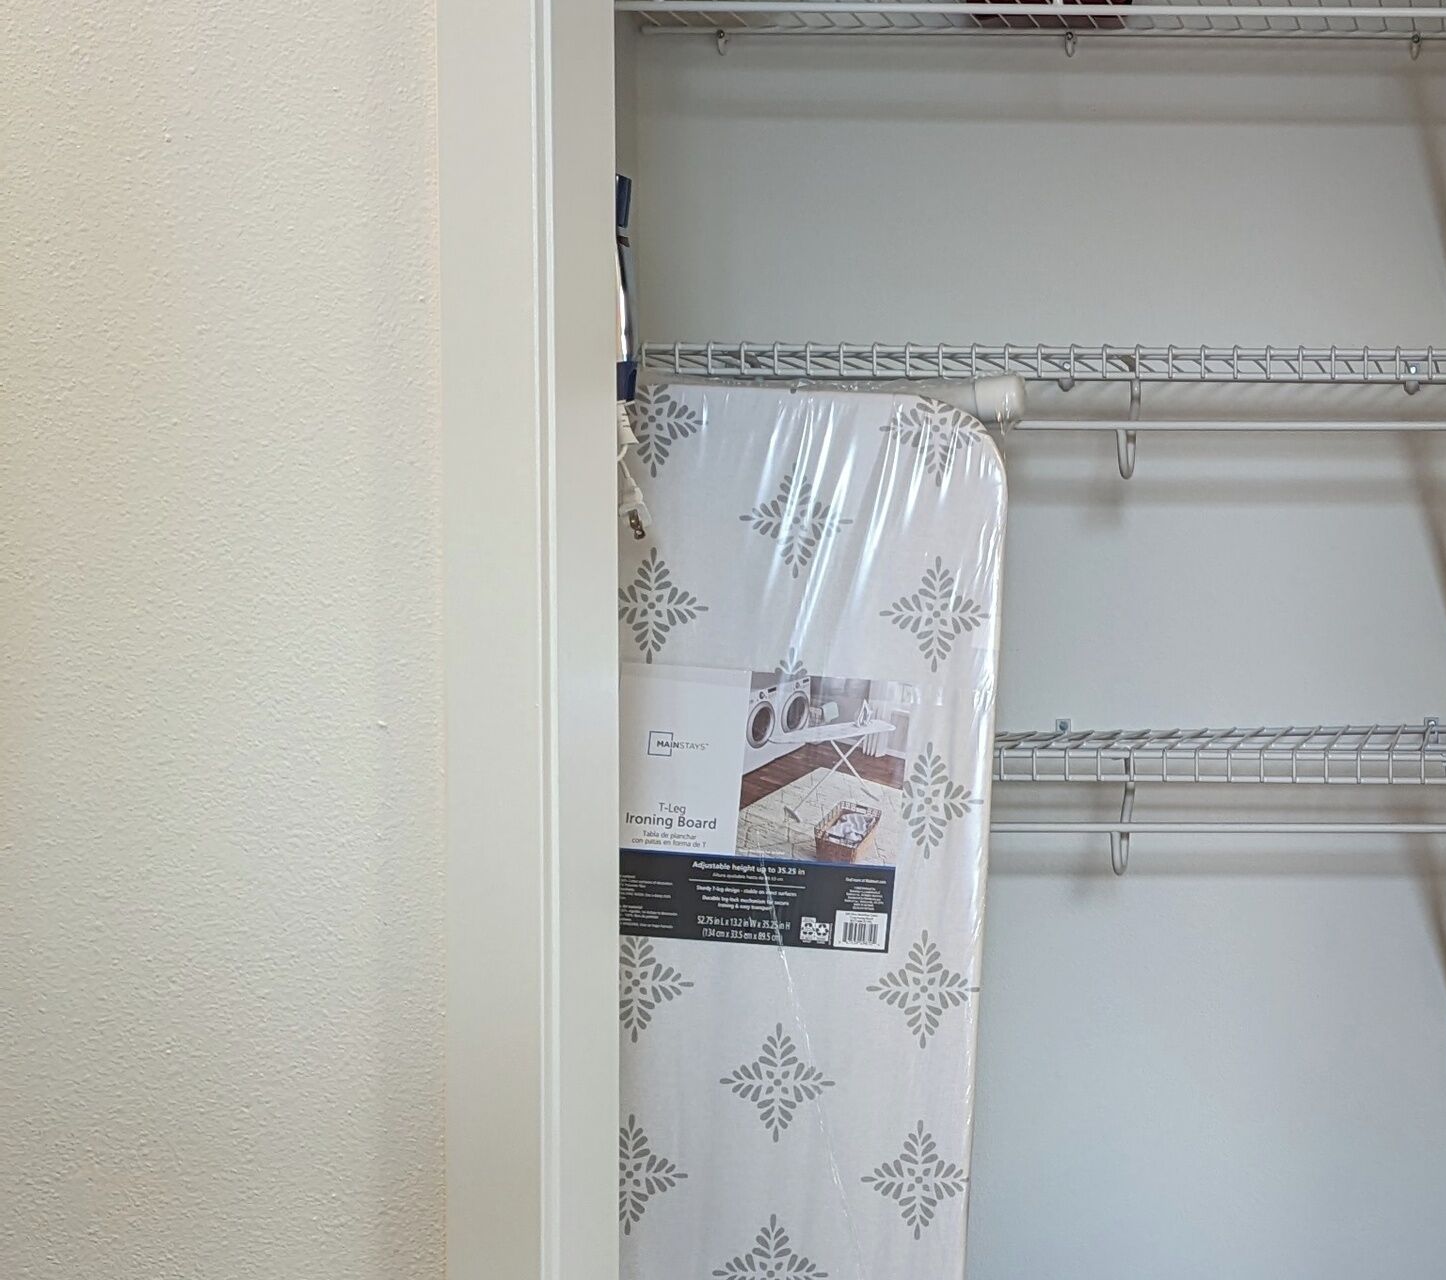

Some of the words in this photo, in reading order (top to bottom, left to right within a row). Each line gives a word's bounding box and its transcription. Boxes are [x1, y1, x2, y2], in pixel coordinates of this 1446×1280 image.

[656, 740, 706, 751] MAINSTAYS
[659, 802, 686, 815] T-Leg
[625, 812, 673, 829] Ironing
[677, 816, 717, 830] Board
[643, 830, 659, 838] Tabla
[661, 831, 669, 839] de
[692, 840, 701, 848] de
[692, 861, 731, 871] Adjustable
[732, 864, 756, 873] height
[777, 867, 797, 875] 35.25
[697, 915, 714, 925] 52.75
[714, 916, 720, 925] in
[720, 917, 725, 925] L
[730, 917, 743, 927] 13.2
[762, 920, 778, 929] 35.25
[702, 927, 716, 938] (134
[716, 930, 725, 938] cm
[730, 929, 743, 939] 33.5
